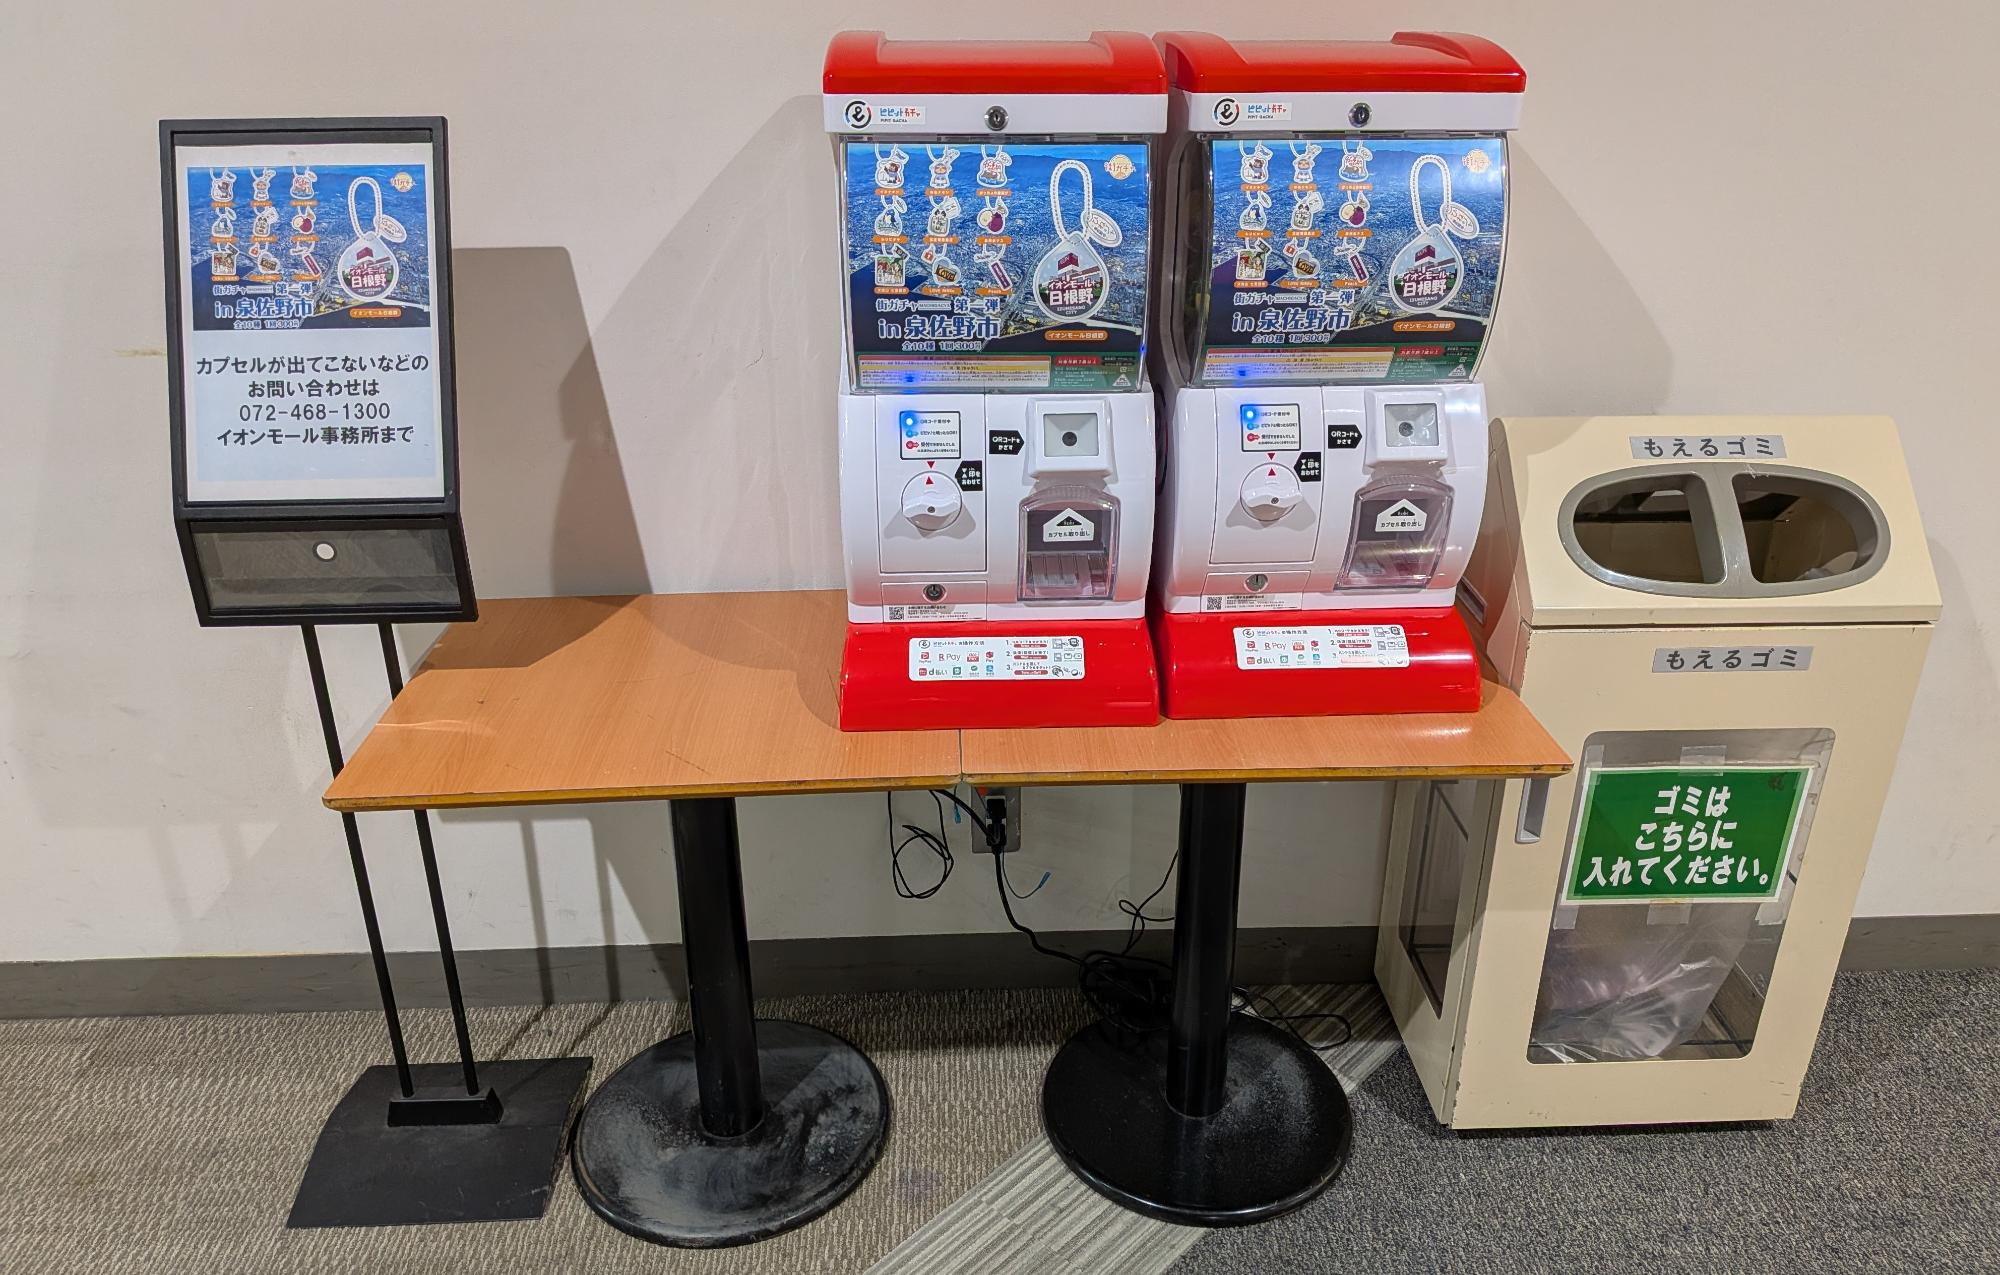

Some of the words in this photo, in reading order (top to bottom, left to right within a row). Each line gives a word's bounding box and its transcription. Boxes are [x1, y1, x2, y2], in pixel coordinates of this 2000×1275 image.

[350, 273, 388, 289] 日根野
[1048, 278, 1093, 290] イオンモール
[1403, 270, 1447, 282] イオンモール
[275, 281, 313, 296] 第一弾
[1049, 287, 1094, 306] 日根野
[1234, 291, 1275, 305] 街ガチャ
[1309, 288, 1355, 307] 第一弾
[1402, 279, 1447, 298] 日根野
[214, 300, 234, 319] in
[236, 297, 315, 319] 泉佐野市
[876, 298, 917, 312] 街ガチャ
[953, 295, 1001, 313] 第一弾
[878, 317, 902, 339] in
[904, 314, 1002, 340] 泉佐野市
[1232, 312, 1255, 332] in
[1256, 307, 1352, 333] 泉佐野市
[196, 354, 430, 375] カプセルが出てこないなどの
[248, 379, 381, 399] お問い合わせは
[239, 402, 391, 422] 072-468-1300
[216, 425, 415, 447] イオンモール事務所まで
[1644, 436, 1774, 458] もえるゴミ
[946, 653, 961, 661] Pay
[1666, 647, 1798, 670] もえるゴミ
[1654, 785, 1732, 818] ゴミは
[1635, 819, 1738, 852] こちらに
[1582, 854, 1769, 888] 入れてください。
